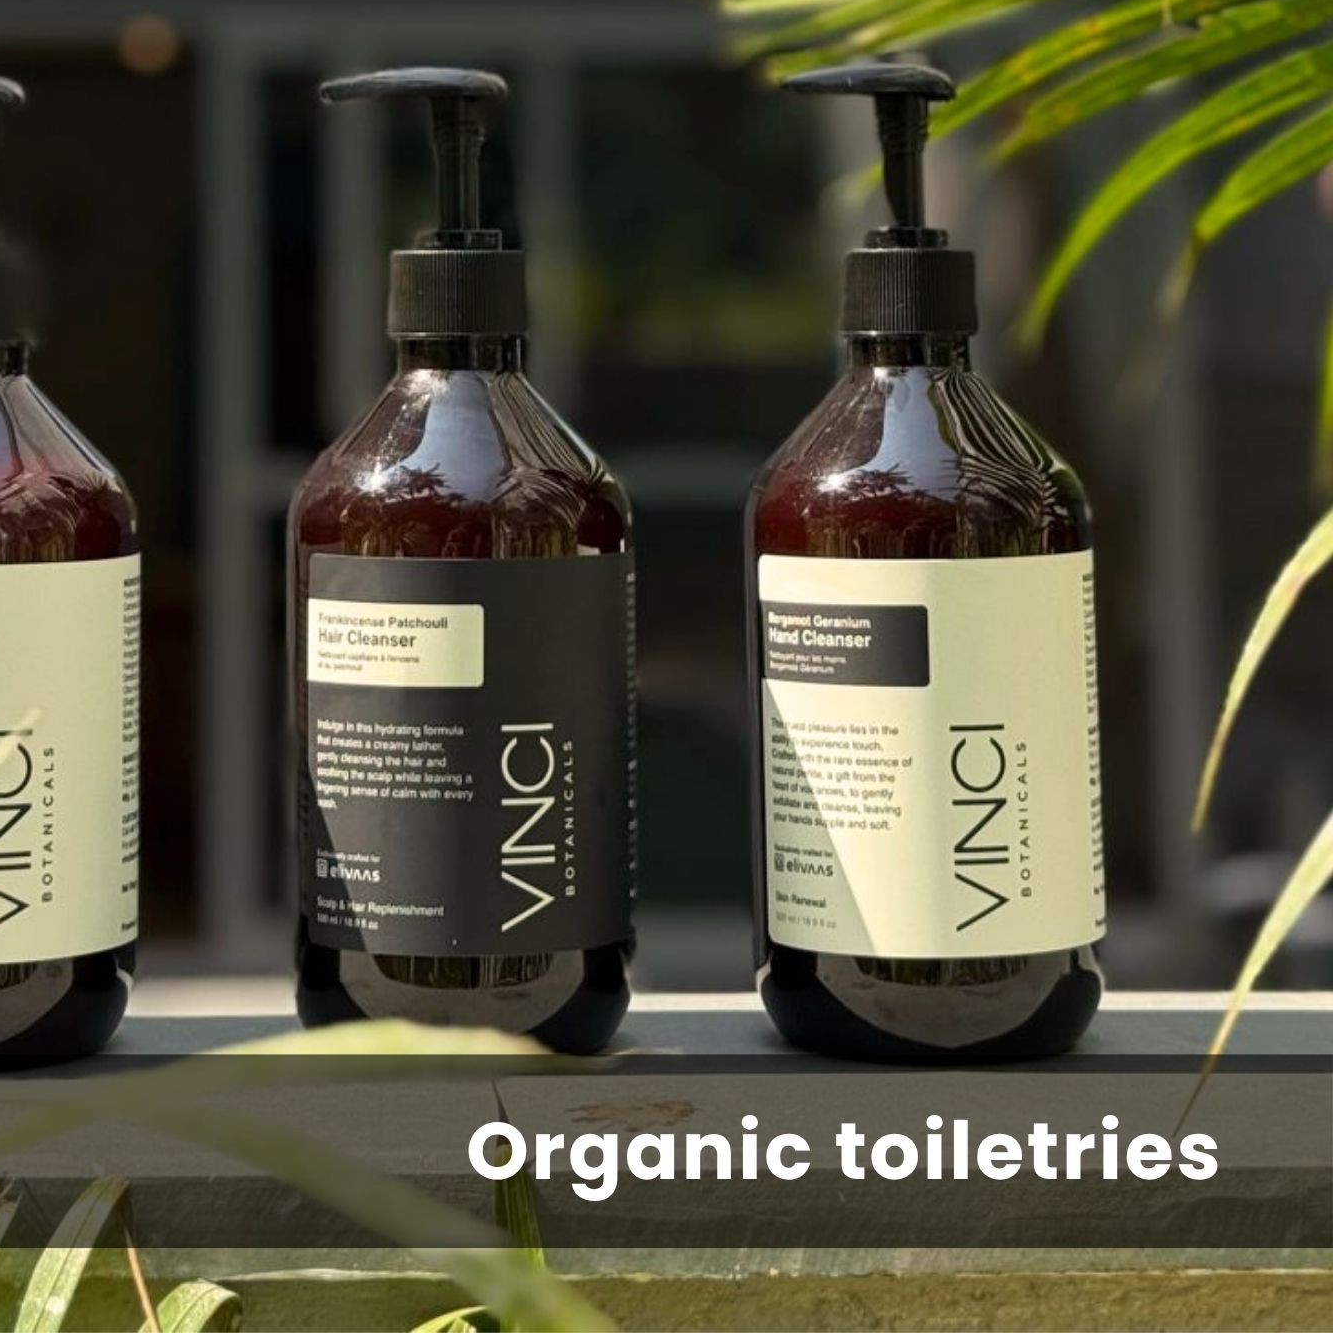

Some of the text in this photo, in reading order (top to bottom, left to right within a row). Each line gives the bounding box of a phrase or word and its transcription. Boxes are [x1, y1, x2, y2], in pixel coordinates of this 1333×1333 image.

[388, 617, 448, 629] Patchouli
[813, 615, 871, 629] Geranium
[319, 628, 417, 647] Hair Cleanser
[768, 627, 871, 648] Hand Cleanser
[356, 722, 373, 733] this
[374, 723, 421, 738] hydrating
[423, 725, 464, 735] formula
[850, 725, 866, 735] lies
[869, 725, 879, 735] in
[881, 725, 899, 736] the
[365, 741, 371, 749] a
[374, 741, 409, 753] creamy
[852, 740, 884, 751] touch.
[340, 753, 382, 767] cleansing
[385, 755, 401, 766] the
[403, 757, 423, 767] hair
[426, 757, 446, 768] and
[855, 757, 899, 767] essence
[902, 757, 913, 768] of
[350, 769, 365, 780] the
[367, 771, 393, 783] scalp
[395, 772, 422, 783] while
[424, 773, 462, 786] leaving
[465, 775, 473, 783] a
[836, 771, 850, 783] gift
[853, 771, 877, 782] from
[879, 772, 896, 783] the
[350, 786, 378, 797] sense
[380, 787, 390, 797] of
[392, 788, 417, 799] calm
[420, 789, 442, 799] with
[443, 791, 473, 803] every
[850, 787, 859, 797] to
[862, 788, 893, 801] gently
[563, 740, 576, 896] BOTANICALS
[863, 804, 901, 817] leaving
[41, 747, 55, 903] BOTANICALS
[848, 819, 866, 829] and
[869, 818, 892, 830] soft.
[1015, 741, 1032, 898] BOTANICALS
[501, 722, 556, 933] VINCI
[949, 723, 1010, 932] VINCI
[368, 901, 444, 916] Replenishment
